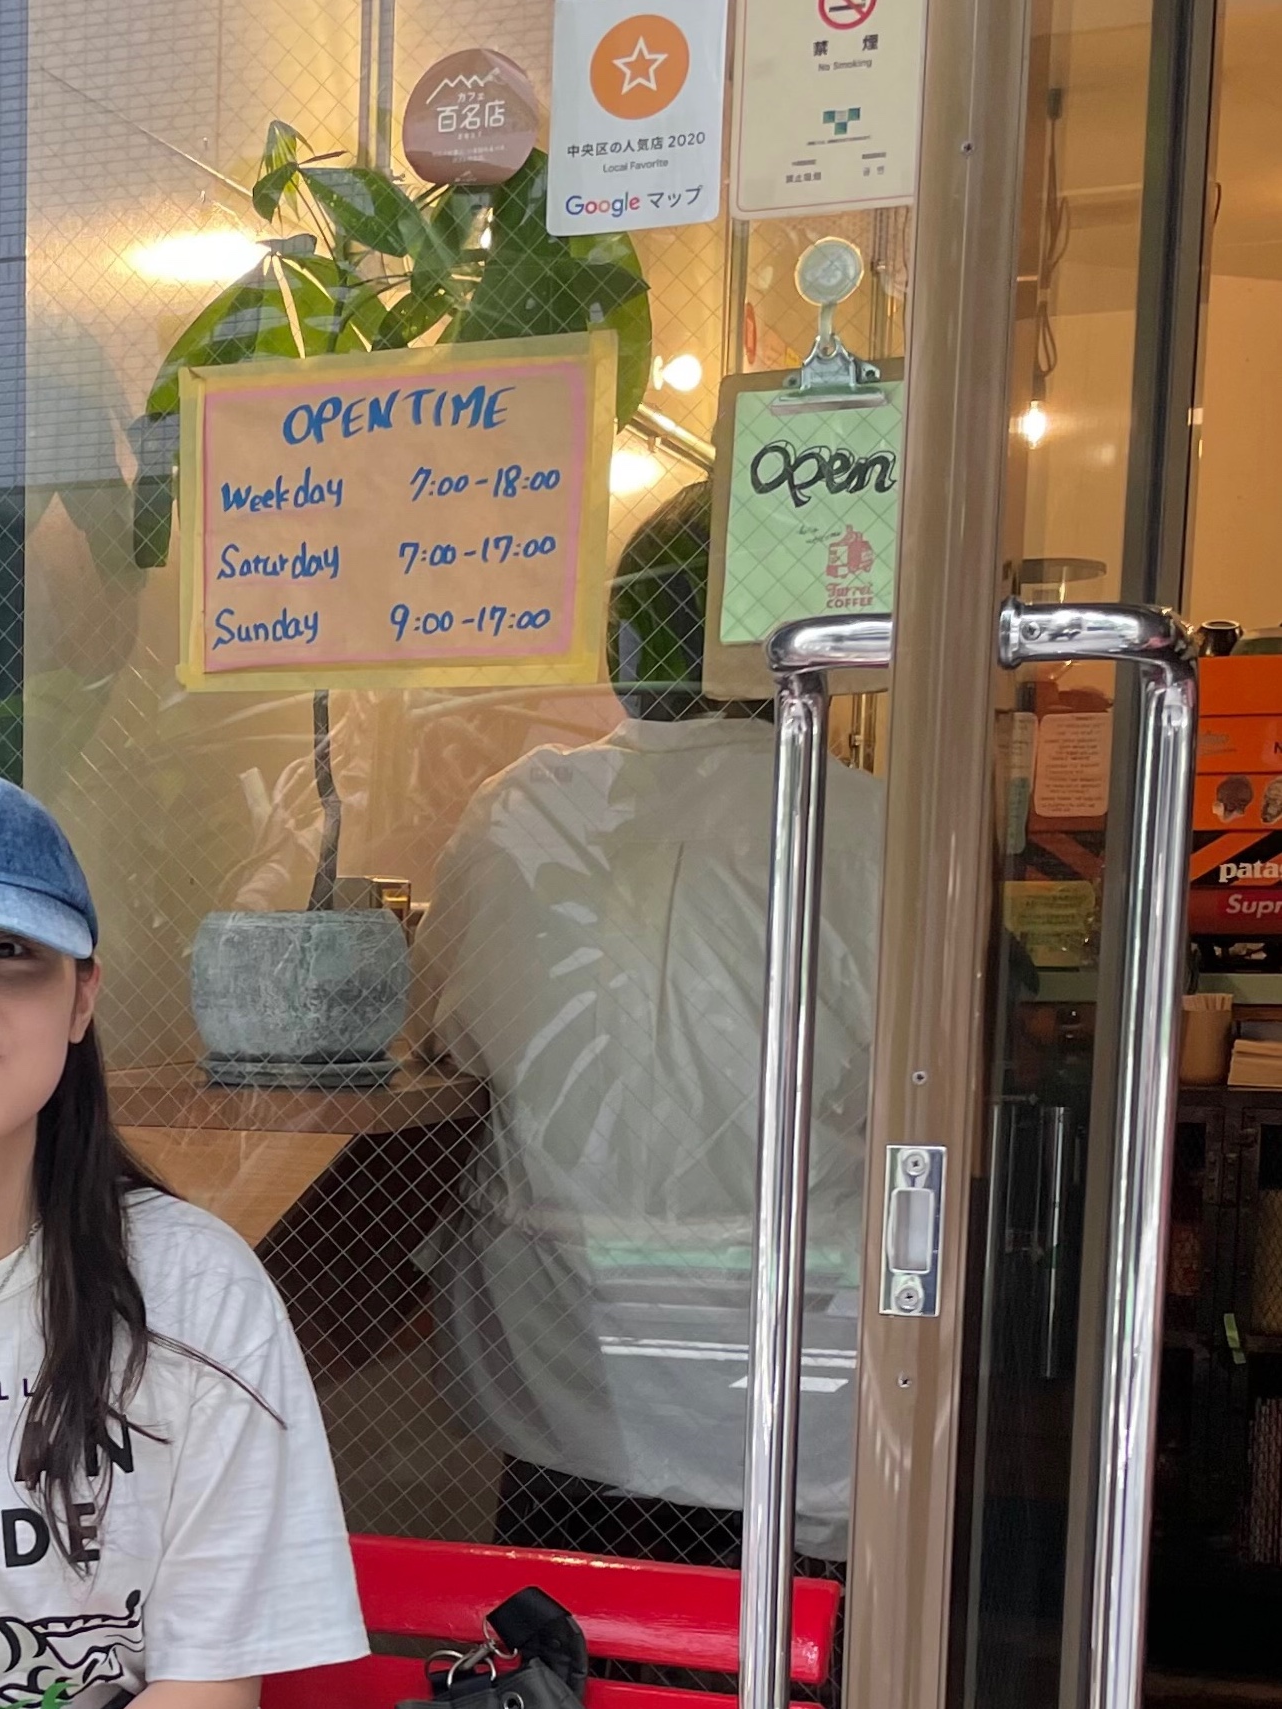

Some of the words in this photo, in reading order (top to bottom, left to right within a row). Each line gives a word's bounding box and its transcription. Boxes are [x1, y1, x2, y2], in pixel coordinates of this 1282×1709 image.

[818, 63, 831, 72] No
[833, 60, 873, 70] Smoking
[458, 92, 485, 103] カフェ
[436, 100, 505, 133] 百名店
[567, 136, 664, 158] 中央区の人気店
[668, 131, 706, 148] 2020
[602, 161, 628, 173] Local
[630, 159, 669, 170] Favorite
[565, 191, 641, 218] Google
[647, 185, 704, 209] マップ
[220, 466, 344, 513] Weekday
[826, 597, 874, 609] COFFEE
[211, 606, 320, 651] Sunday
